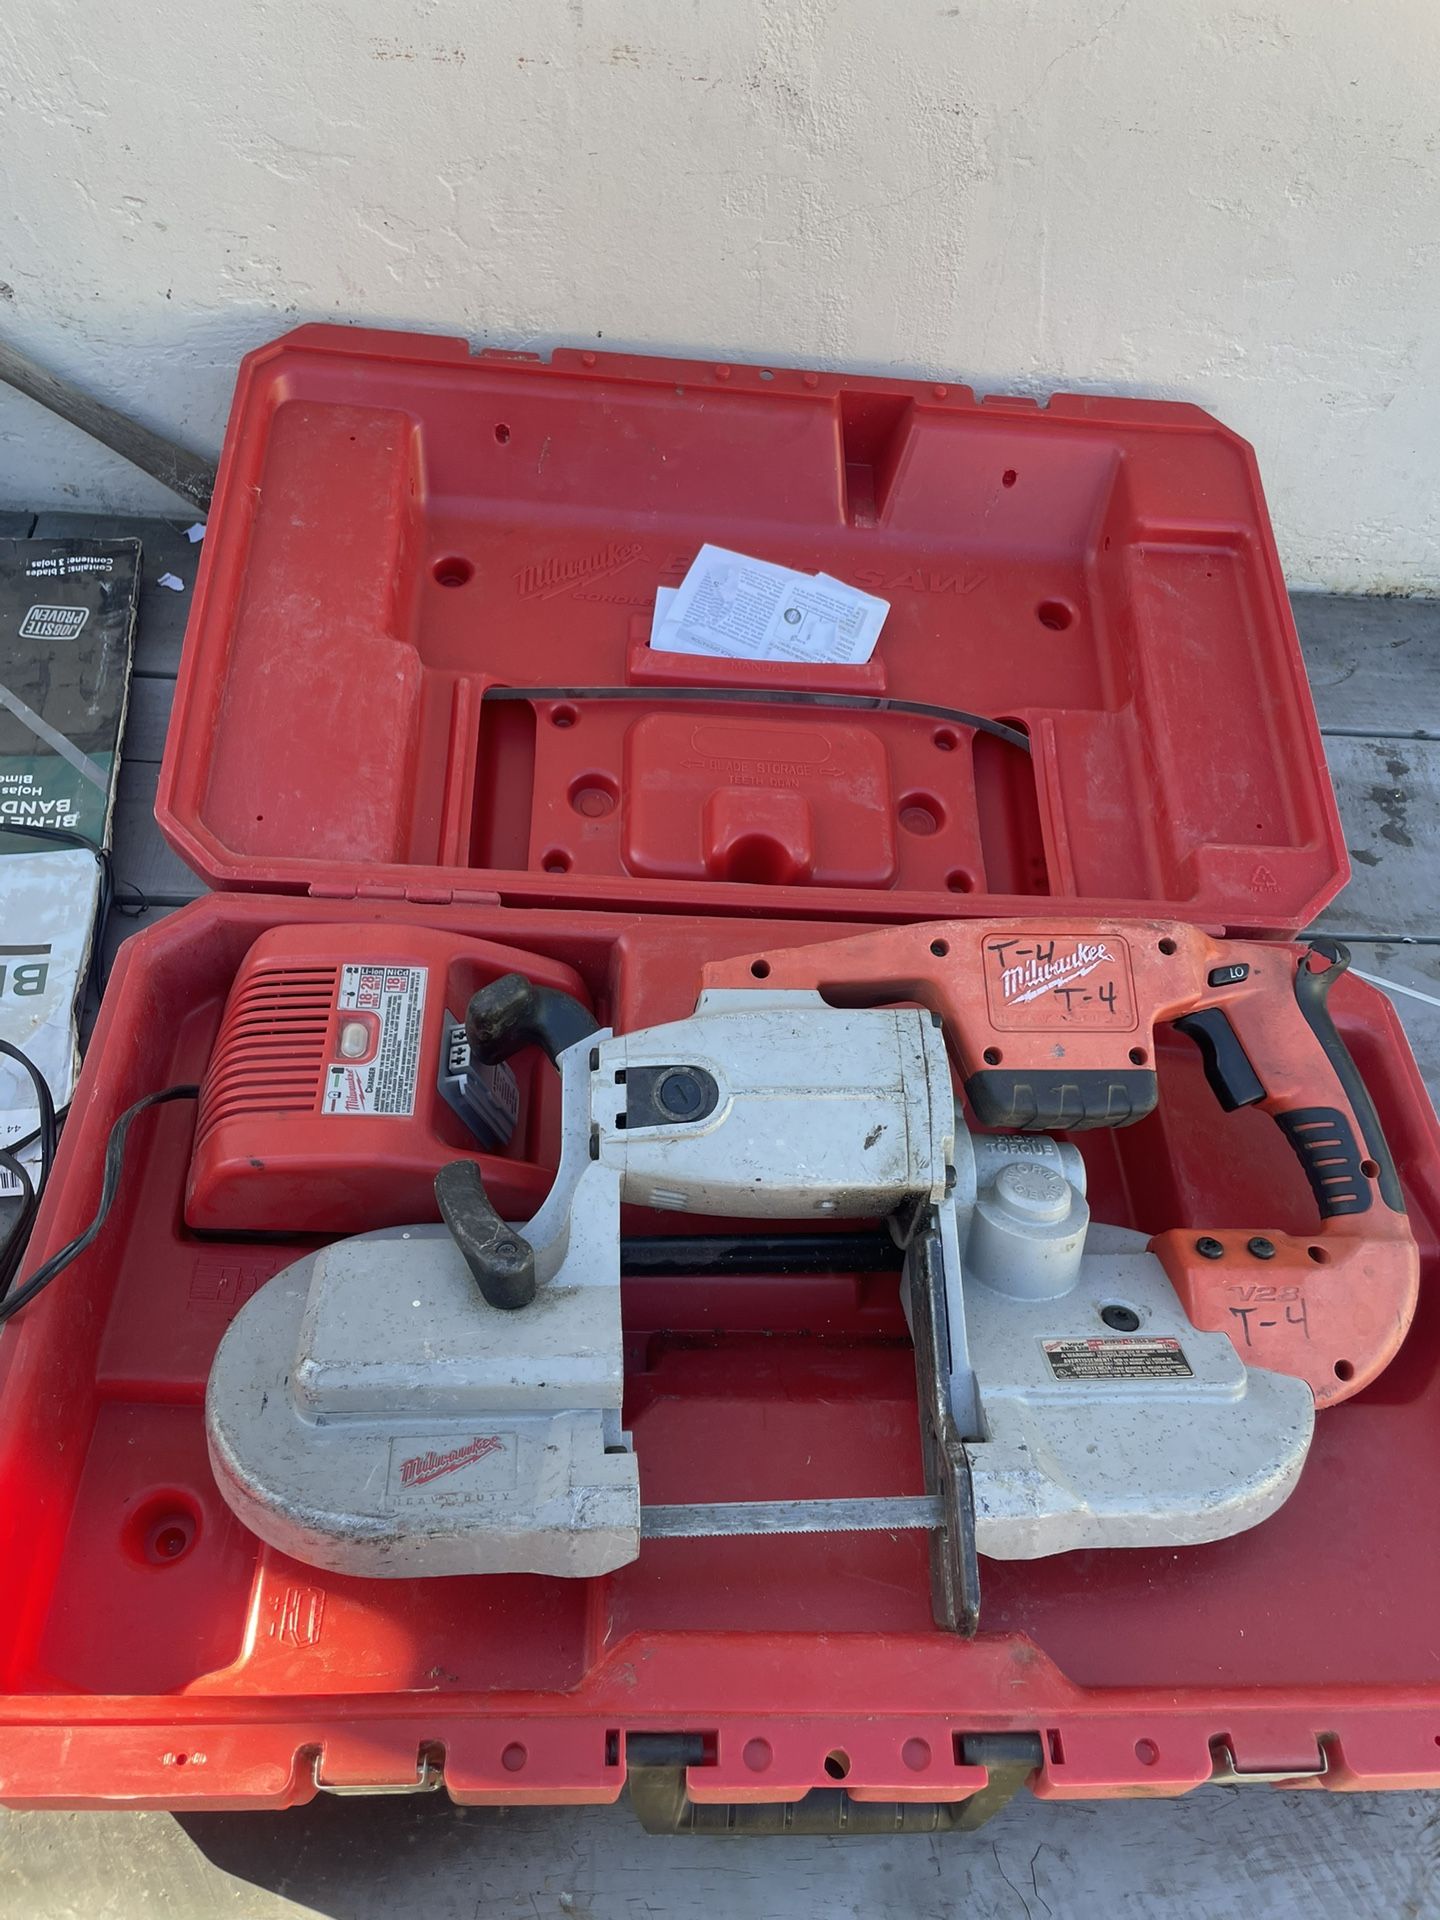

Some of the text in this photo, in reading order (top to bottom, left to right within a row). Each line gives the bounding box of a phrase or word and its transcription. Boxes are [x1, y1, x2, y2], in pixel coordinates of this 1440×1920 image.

[31, 556, 114, 568] Contiene: 3 hojas
[512, 543, 642, 595] Milwaukee
[25, 564, 113, 577] Contains: 3 blades
[852, 568, 987, 595] SAW
[30, 608, 84, 625] PROVEN
[25, 620, 78, 636] JOBSITE
[710, 760, 812, 776] BLADE STORAGE
[729, 775, 800, 788] TEETH DOWN
[2, 786, 43, 796] Hojas
[1, 799, 71, 815] BAND
[987, 940, 1055, 968] T-4
[361, 968, 384, 976] Li-ion
[387, 969, 410, 977] NiCd
[1000, 943, 1106, 998] Milwaukee
[1230, 966, 1245, 979] LO
[387, 978, 400, 990] 18
[1053, 981, 1117, 1015] T-4
[343, 1068, 358, 1112] Milwaukee
[997, 1134, 1037, 1143] HIGH
[985, 1143, 1055, 1156] TORQUE
[1006, 1164, 1059, 1182] WORM
[1226, 1286, 1299, 1301] V28
[1228, 1297, 1311, 1348] T-4
[400, 1435, 503, 1483] Milwaukee
[463, 1493, 510, 1504] DUTY
